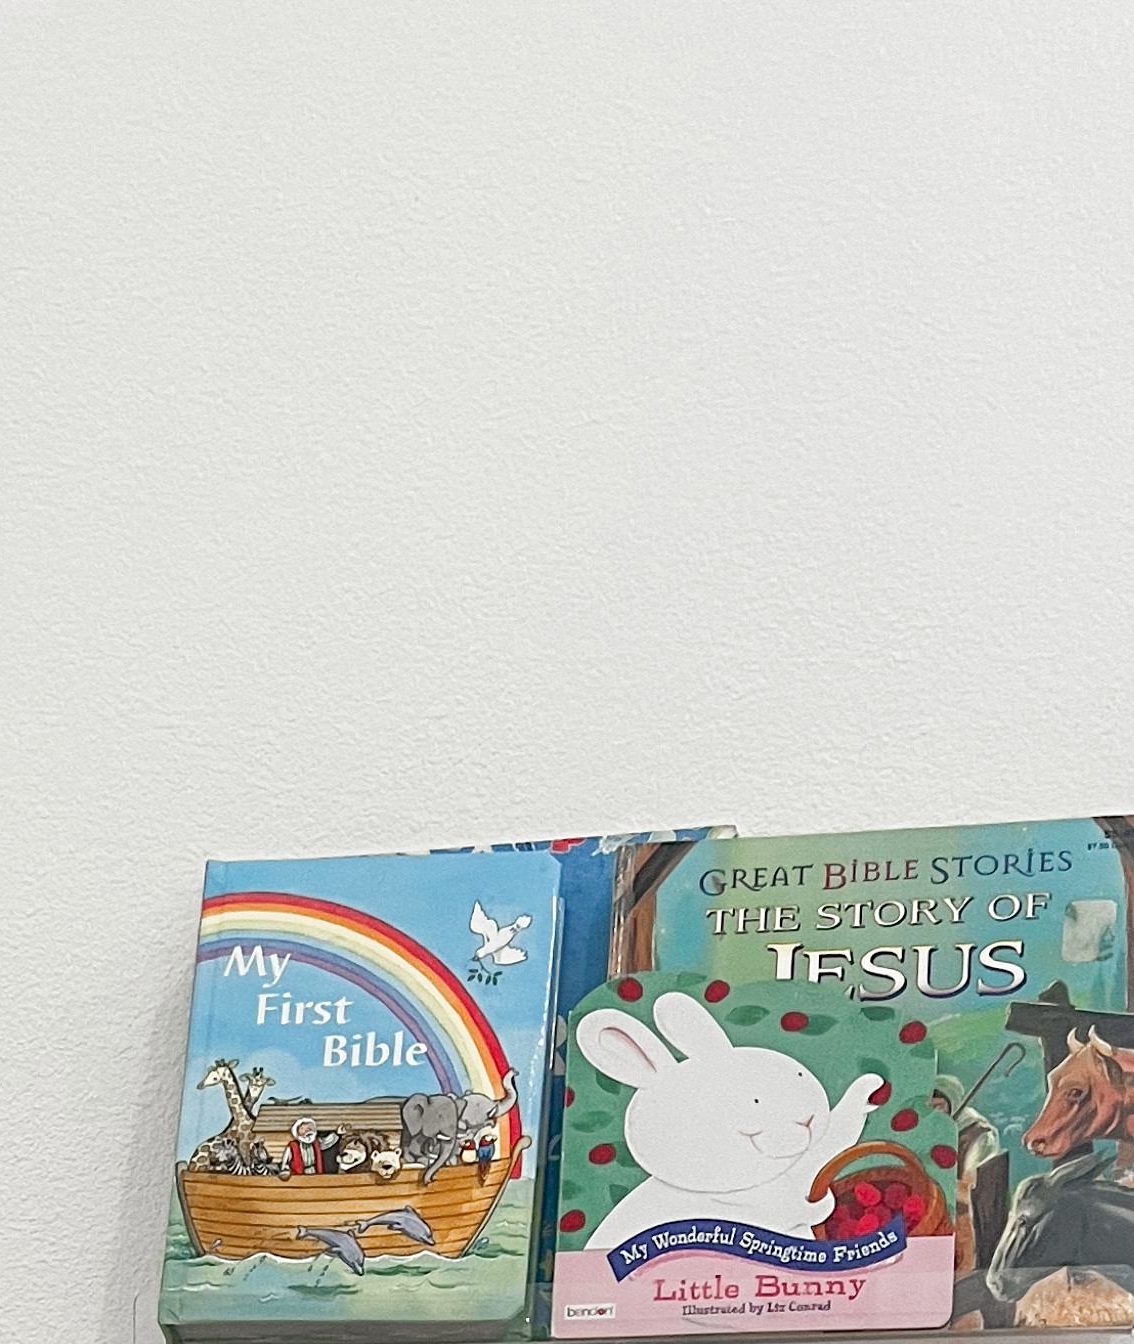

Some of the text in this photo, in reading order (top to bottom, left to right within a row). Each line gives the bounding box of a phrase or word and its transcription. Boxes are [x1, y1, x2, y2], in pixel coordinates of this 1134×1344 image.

[699, 847, 1074, 896] GREAT BIBLE STORIES
[706, 889, 1053, 937] THE STORY OF
[223, 944, 291, 985] My
[767, 939, 1028, 1003] JESUS
[256, 994, 354, 1027] First
[323, 1031, 429, 1069] Bible
[620, 1226, 899, 1265] My Wonderful Springtime Friends
[653, 1273, 868, 1302] Little Bunny
[682, 1300, 832, 1316] Illustrated by Liz Conrad
